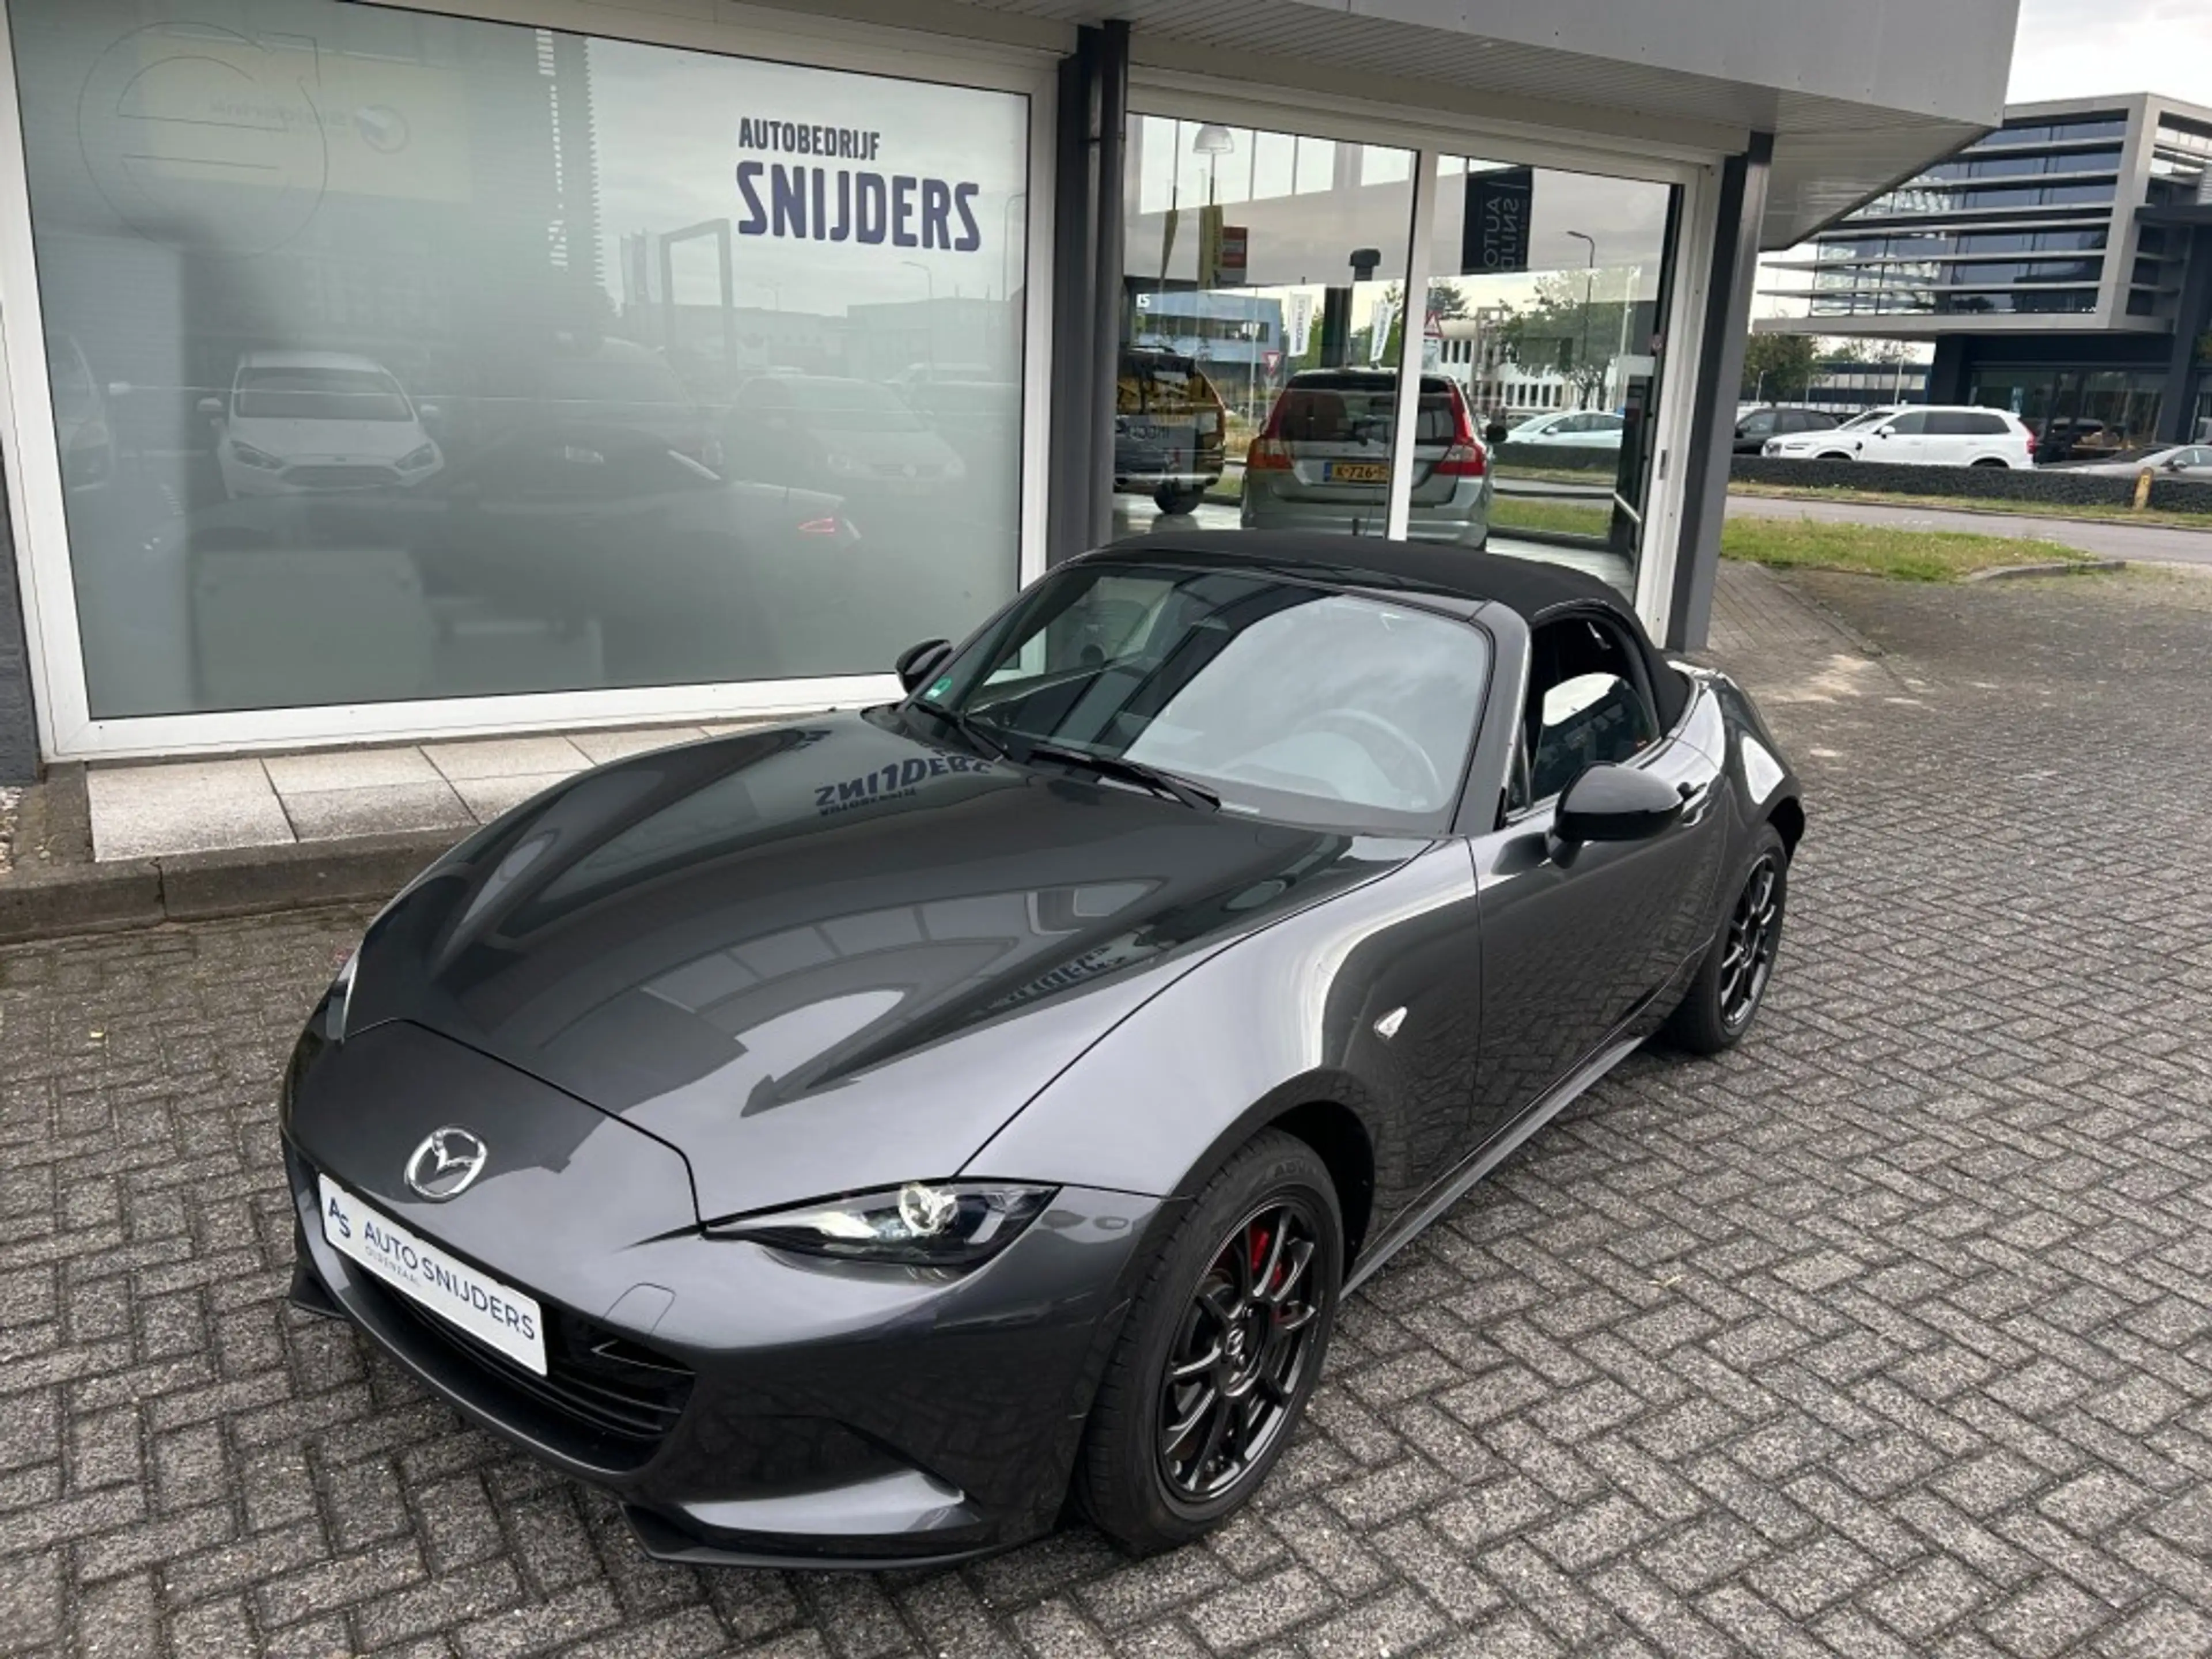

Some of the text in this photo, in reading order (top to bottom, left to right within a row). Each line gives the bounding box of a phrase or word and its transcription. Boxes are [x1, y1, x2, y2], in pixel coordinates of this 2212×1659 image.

[738, 117, 880, 161] AUTOBEDRIJF
[736, 160, 980, 252] SNIJDERS
[364, 1221, 536, 1341] AUTO SNIJDERS
